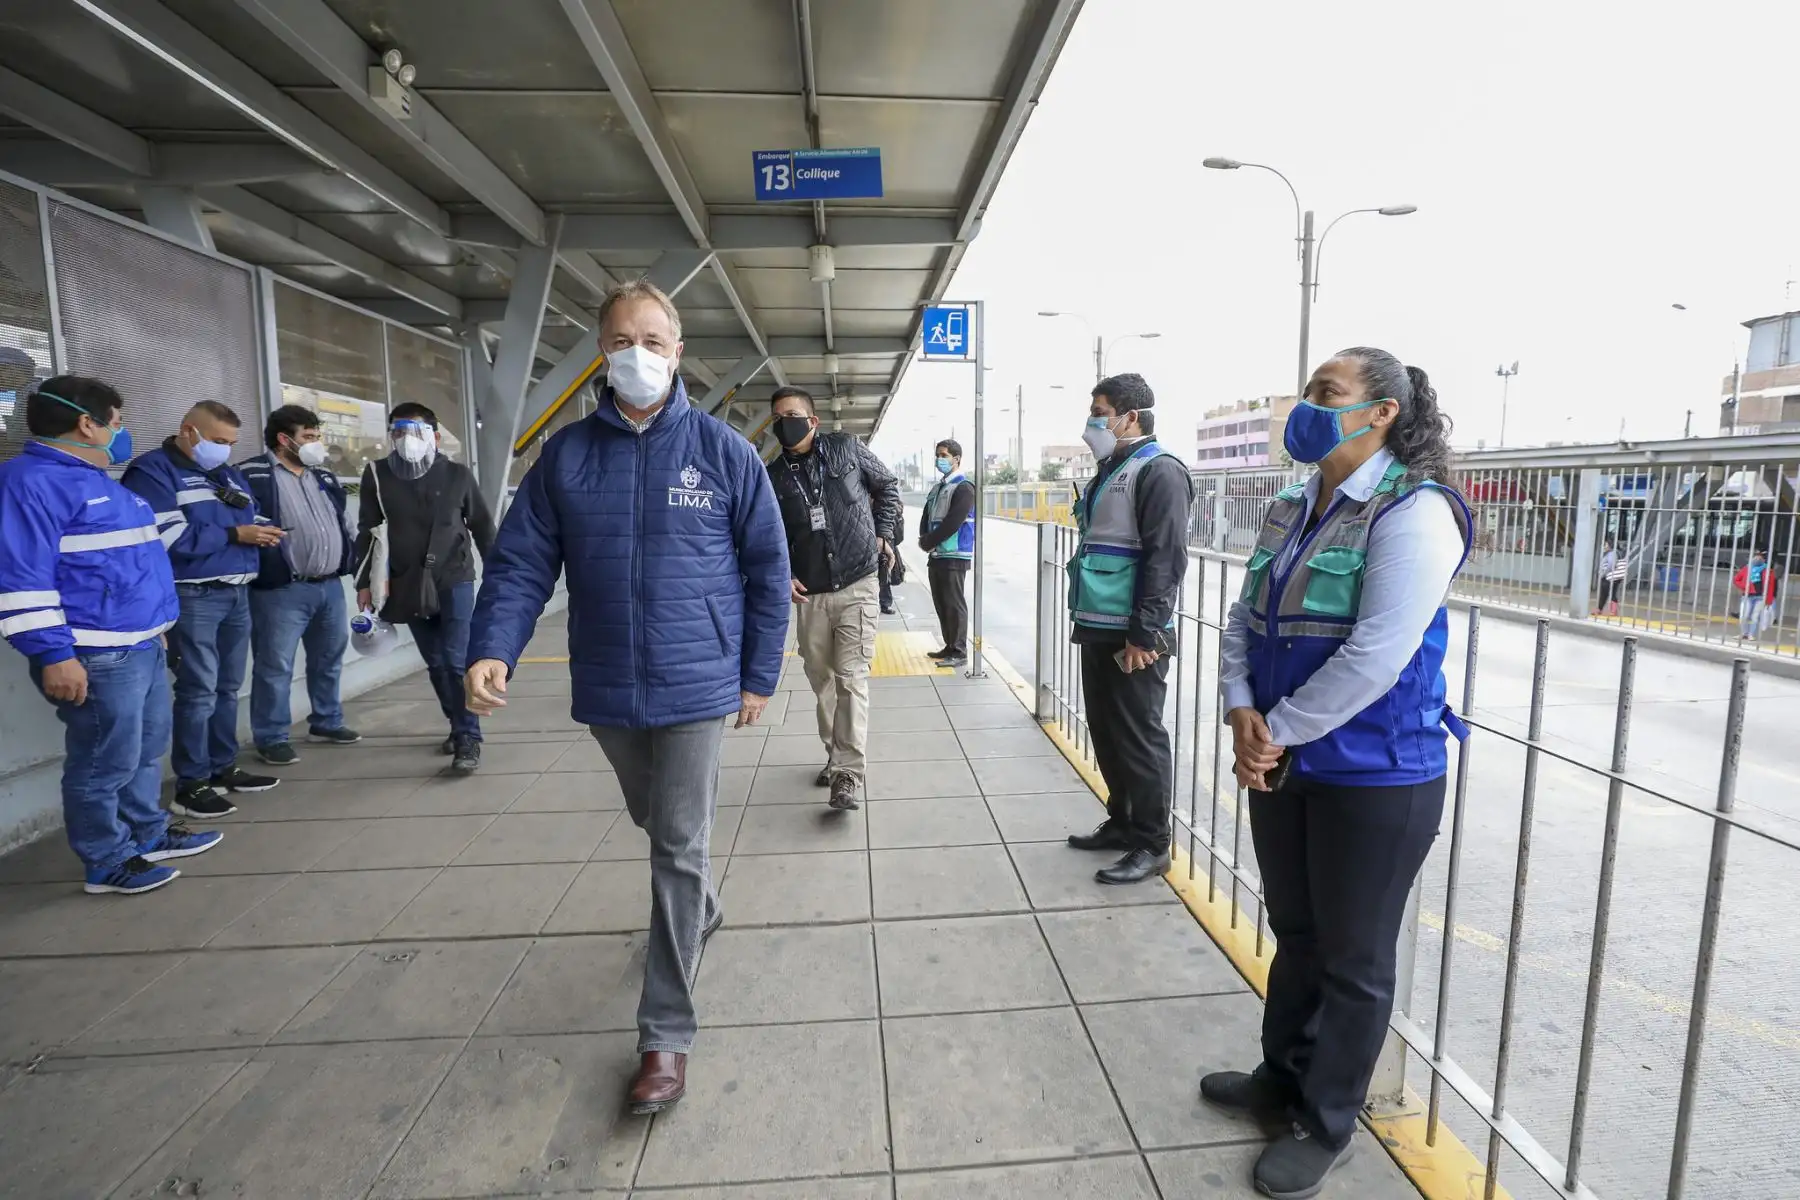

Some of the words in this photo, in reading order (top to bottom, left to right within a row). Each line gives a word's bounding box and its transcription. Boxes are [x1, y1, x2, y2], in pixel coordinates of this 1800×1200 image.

[757, 153, 790, 161] Embarque
[761, 164, 790, 191] 13
[796, 168, 840, 181] Collique
[668, 494, 712, 510] LIMA
